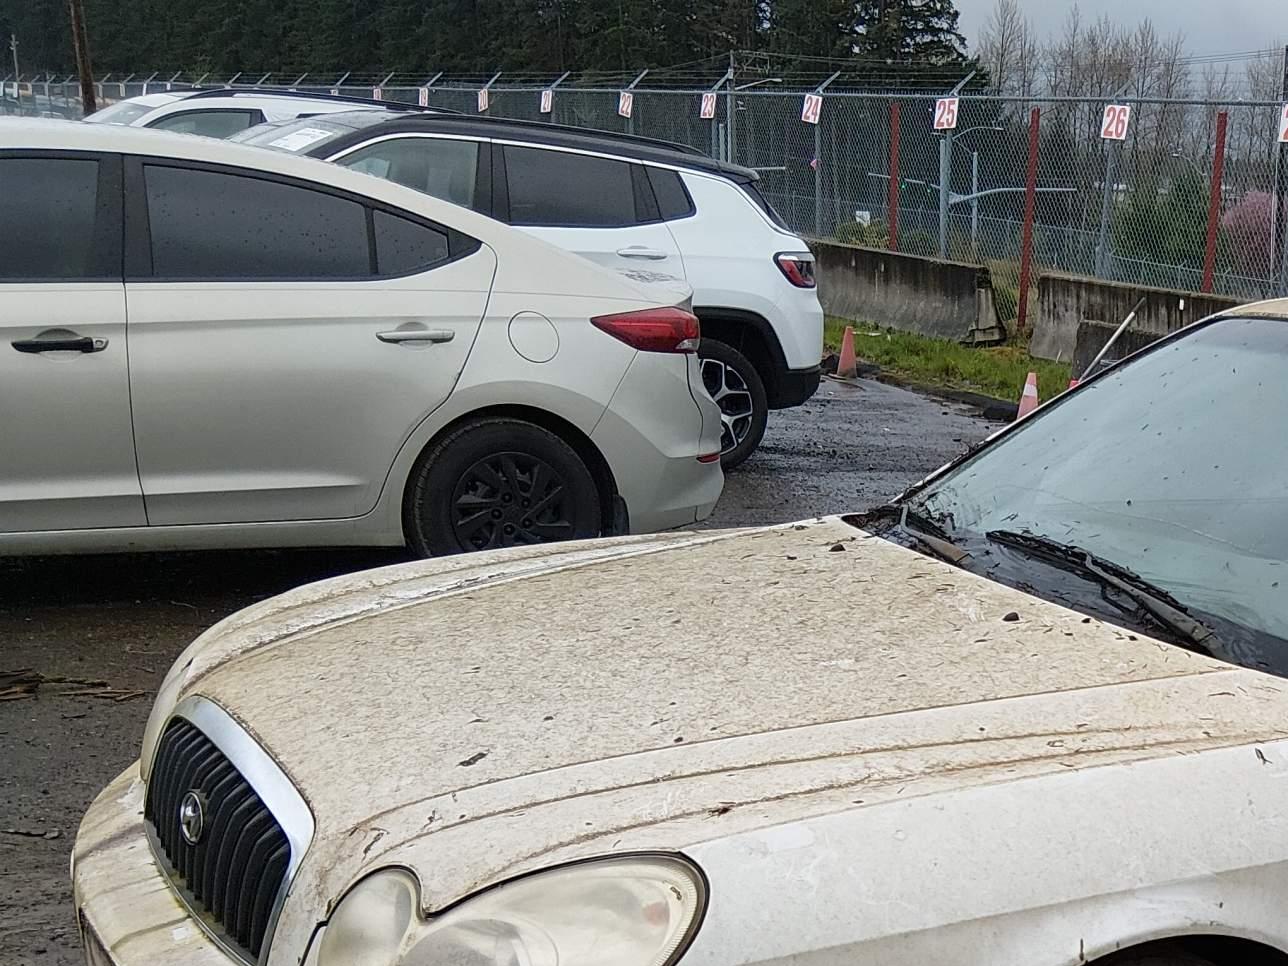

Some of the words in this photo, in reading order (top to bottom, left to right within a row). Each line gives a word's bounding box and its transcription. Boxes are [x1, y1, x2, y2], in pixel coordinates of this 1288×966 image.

[620, 94, 632, 116] 22
[702, 94, 715, 118] 23
[803, 95, 818, 122] 24
[935, 100, 956, 127] 25
[1103, 106, 1128, 138] 26
